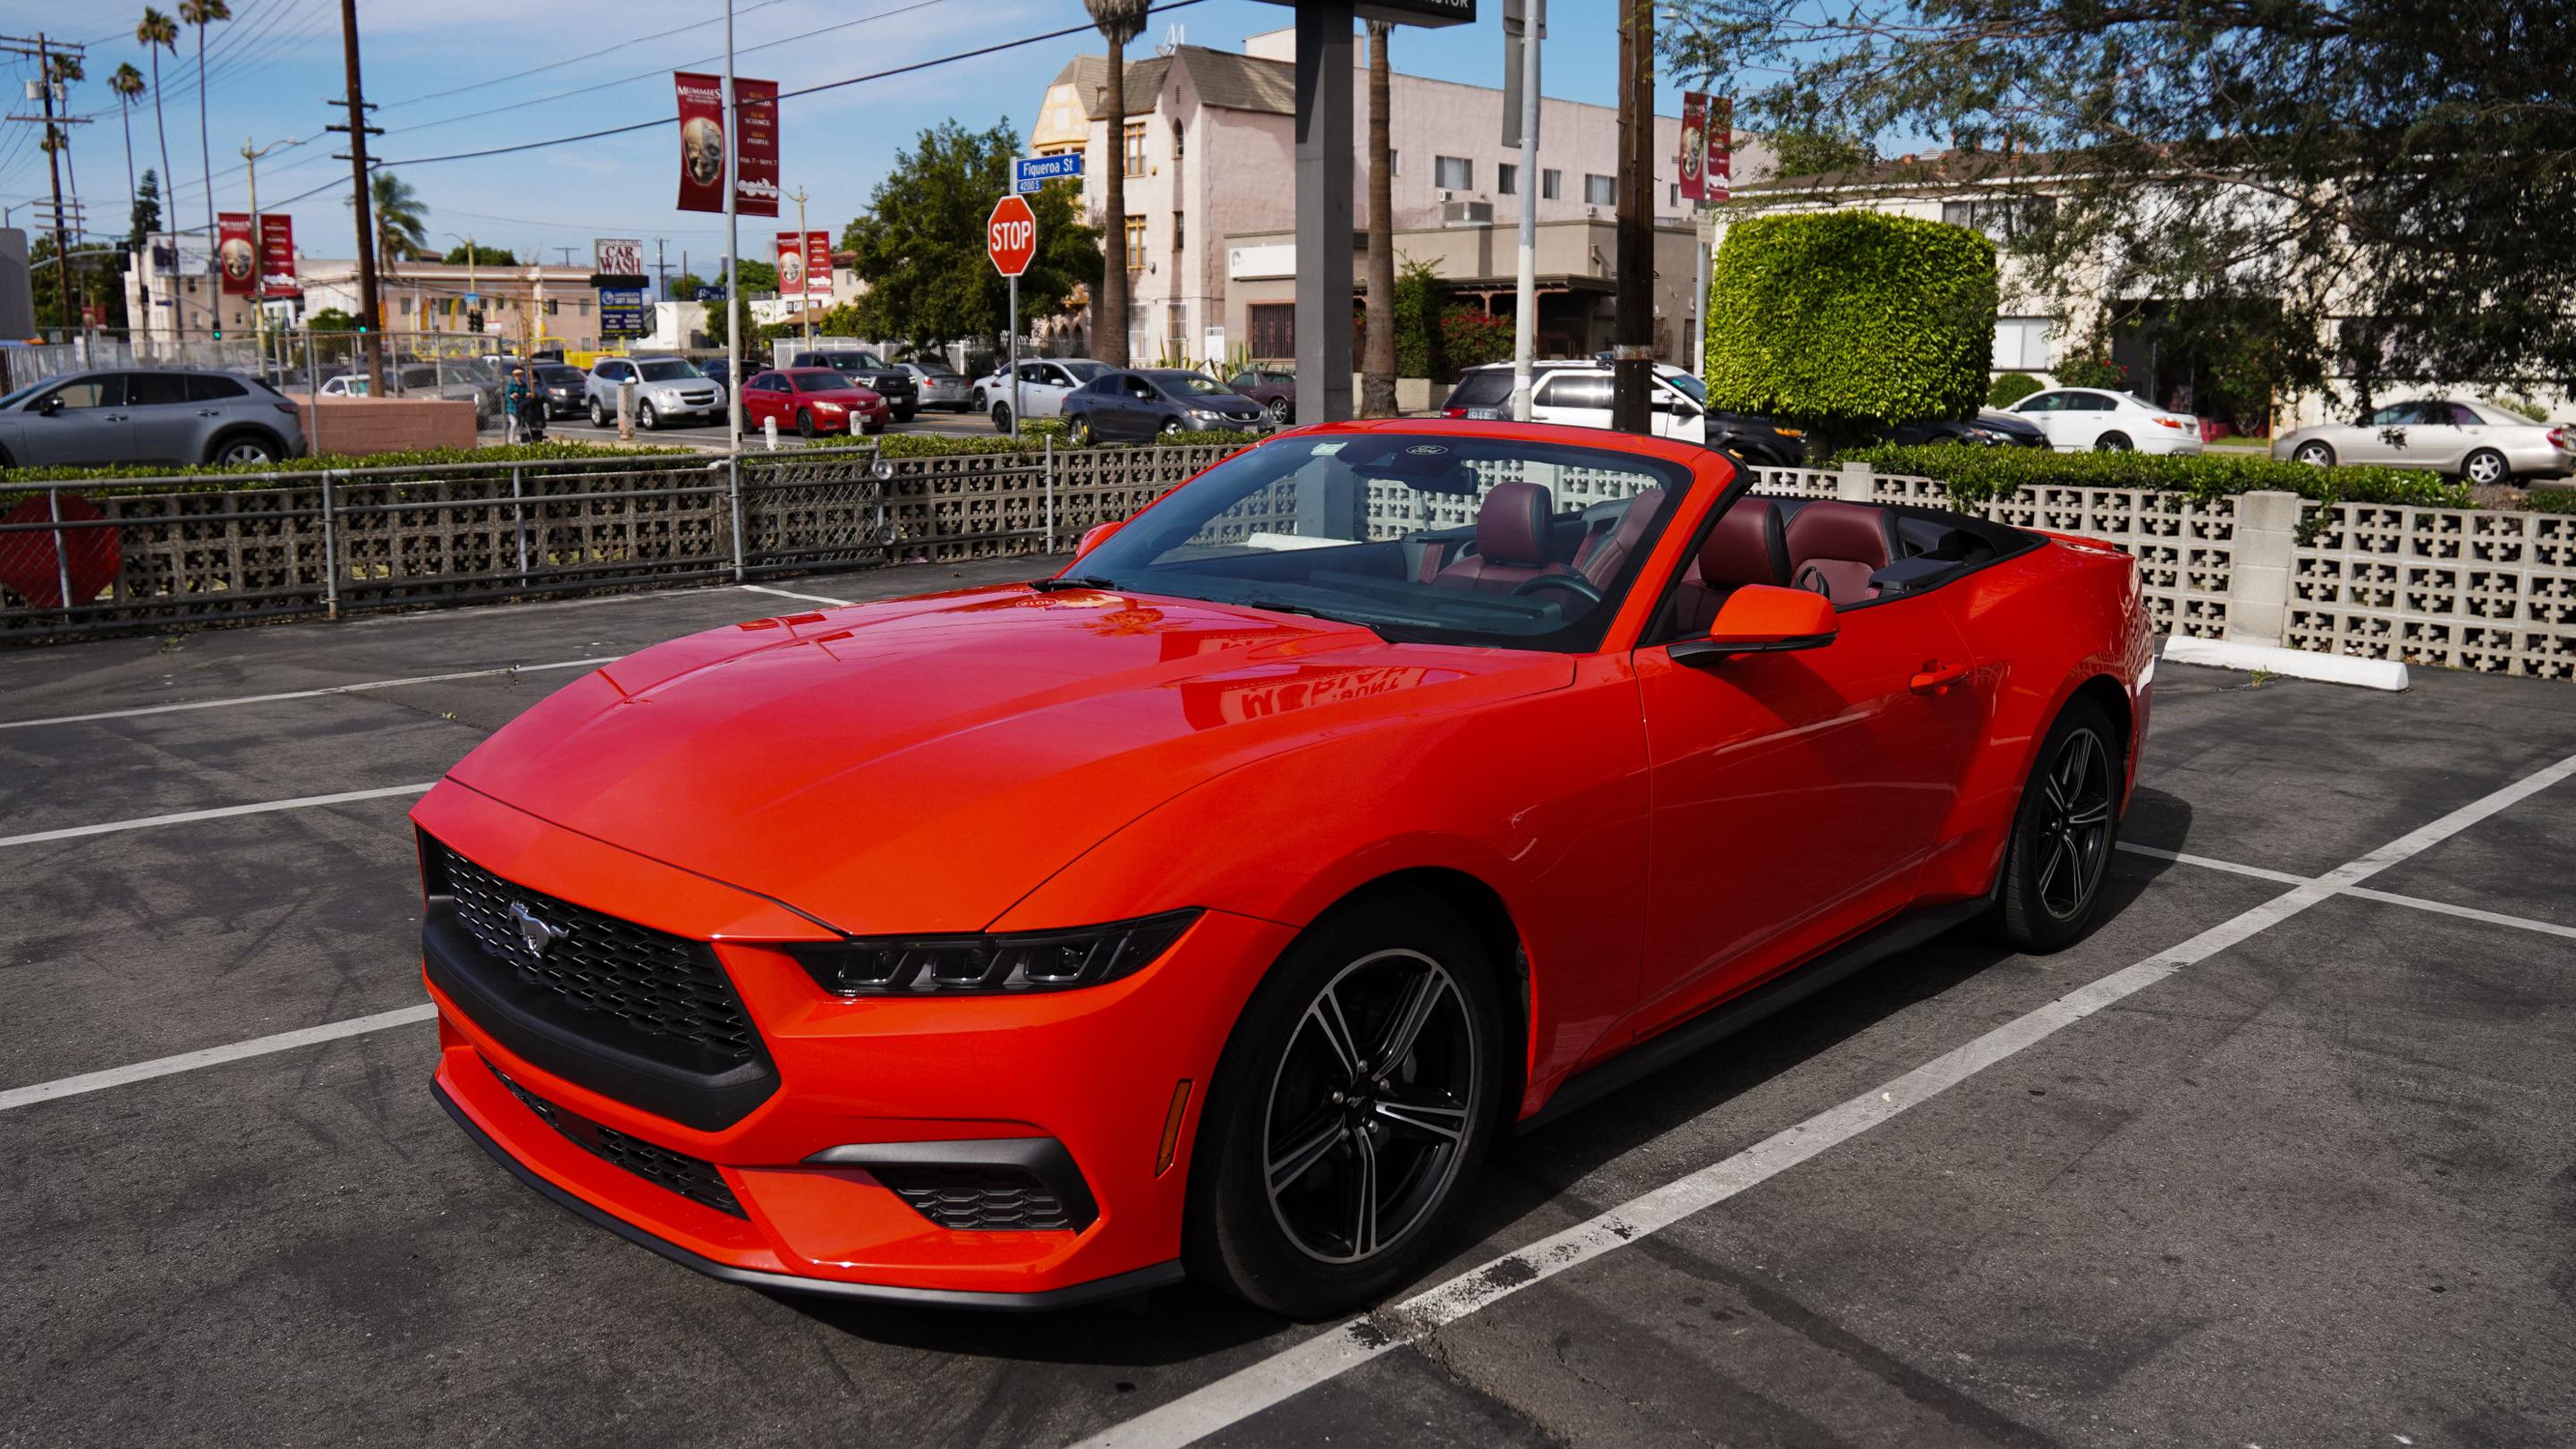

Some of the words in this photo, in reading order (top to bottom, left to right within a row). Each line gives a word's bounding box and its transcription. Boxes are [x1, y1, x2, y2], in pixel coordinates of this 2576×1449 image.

[677, 85, 721, 98] MUMMIES
[1023, 162, 1060, 177] Figueroa
[1063, 158, 1072, 172] St
[1020, 182, 1034, 191] 4200
[1036, 181, 1039, 189] S
[992, 220, 1031, 251] STOP
[606, 246, 634, 258] CAR
[600, 257, 640, 273] WASH
